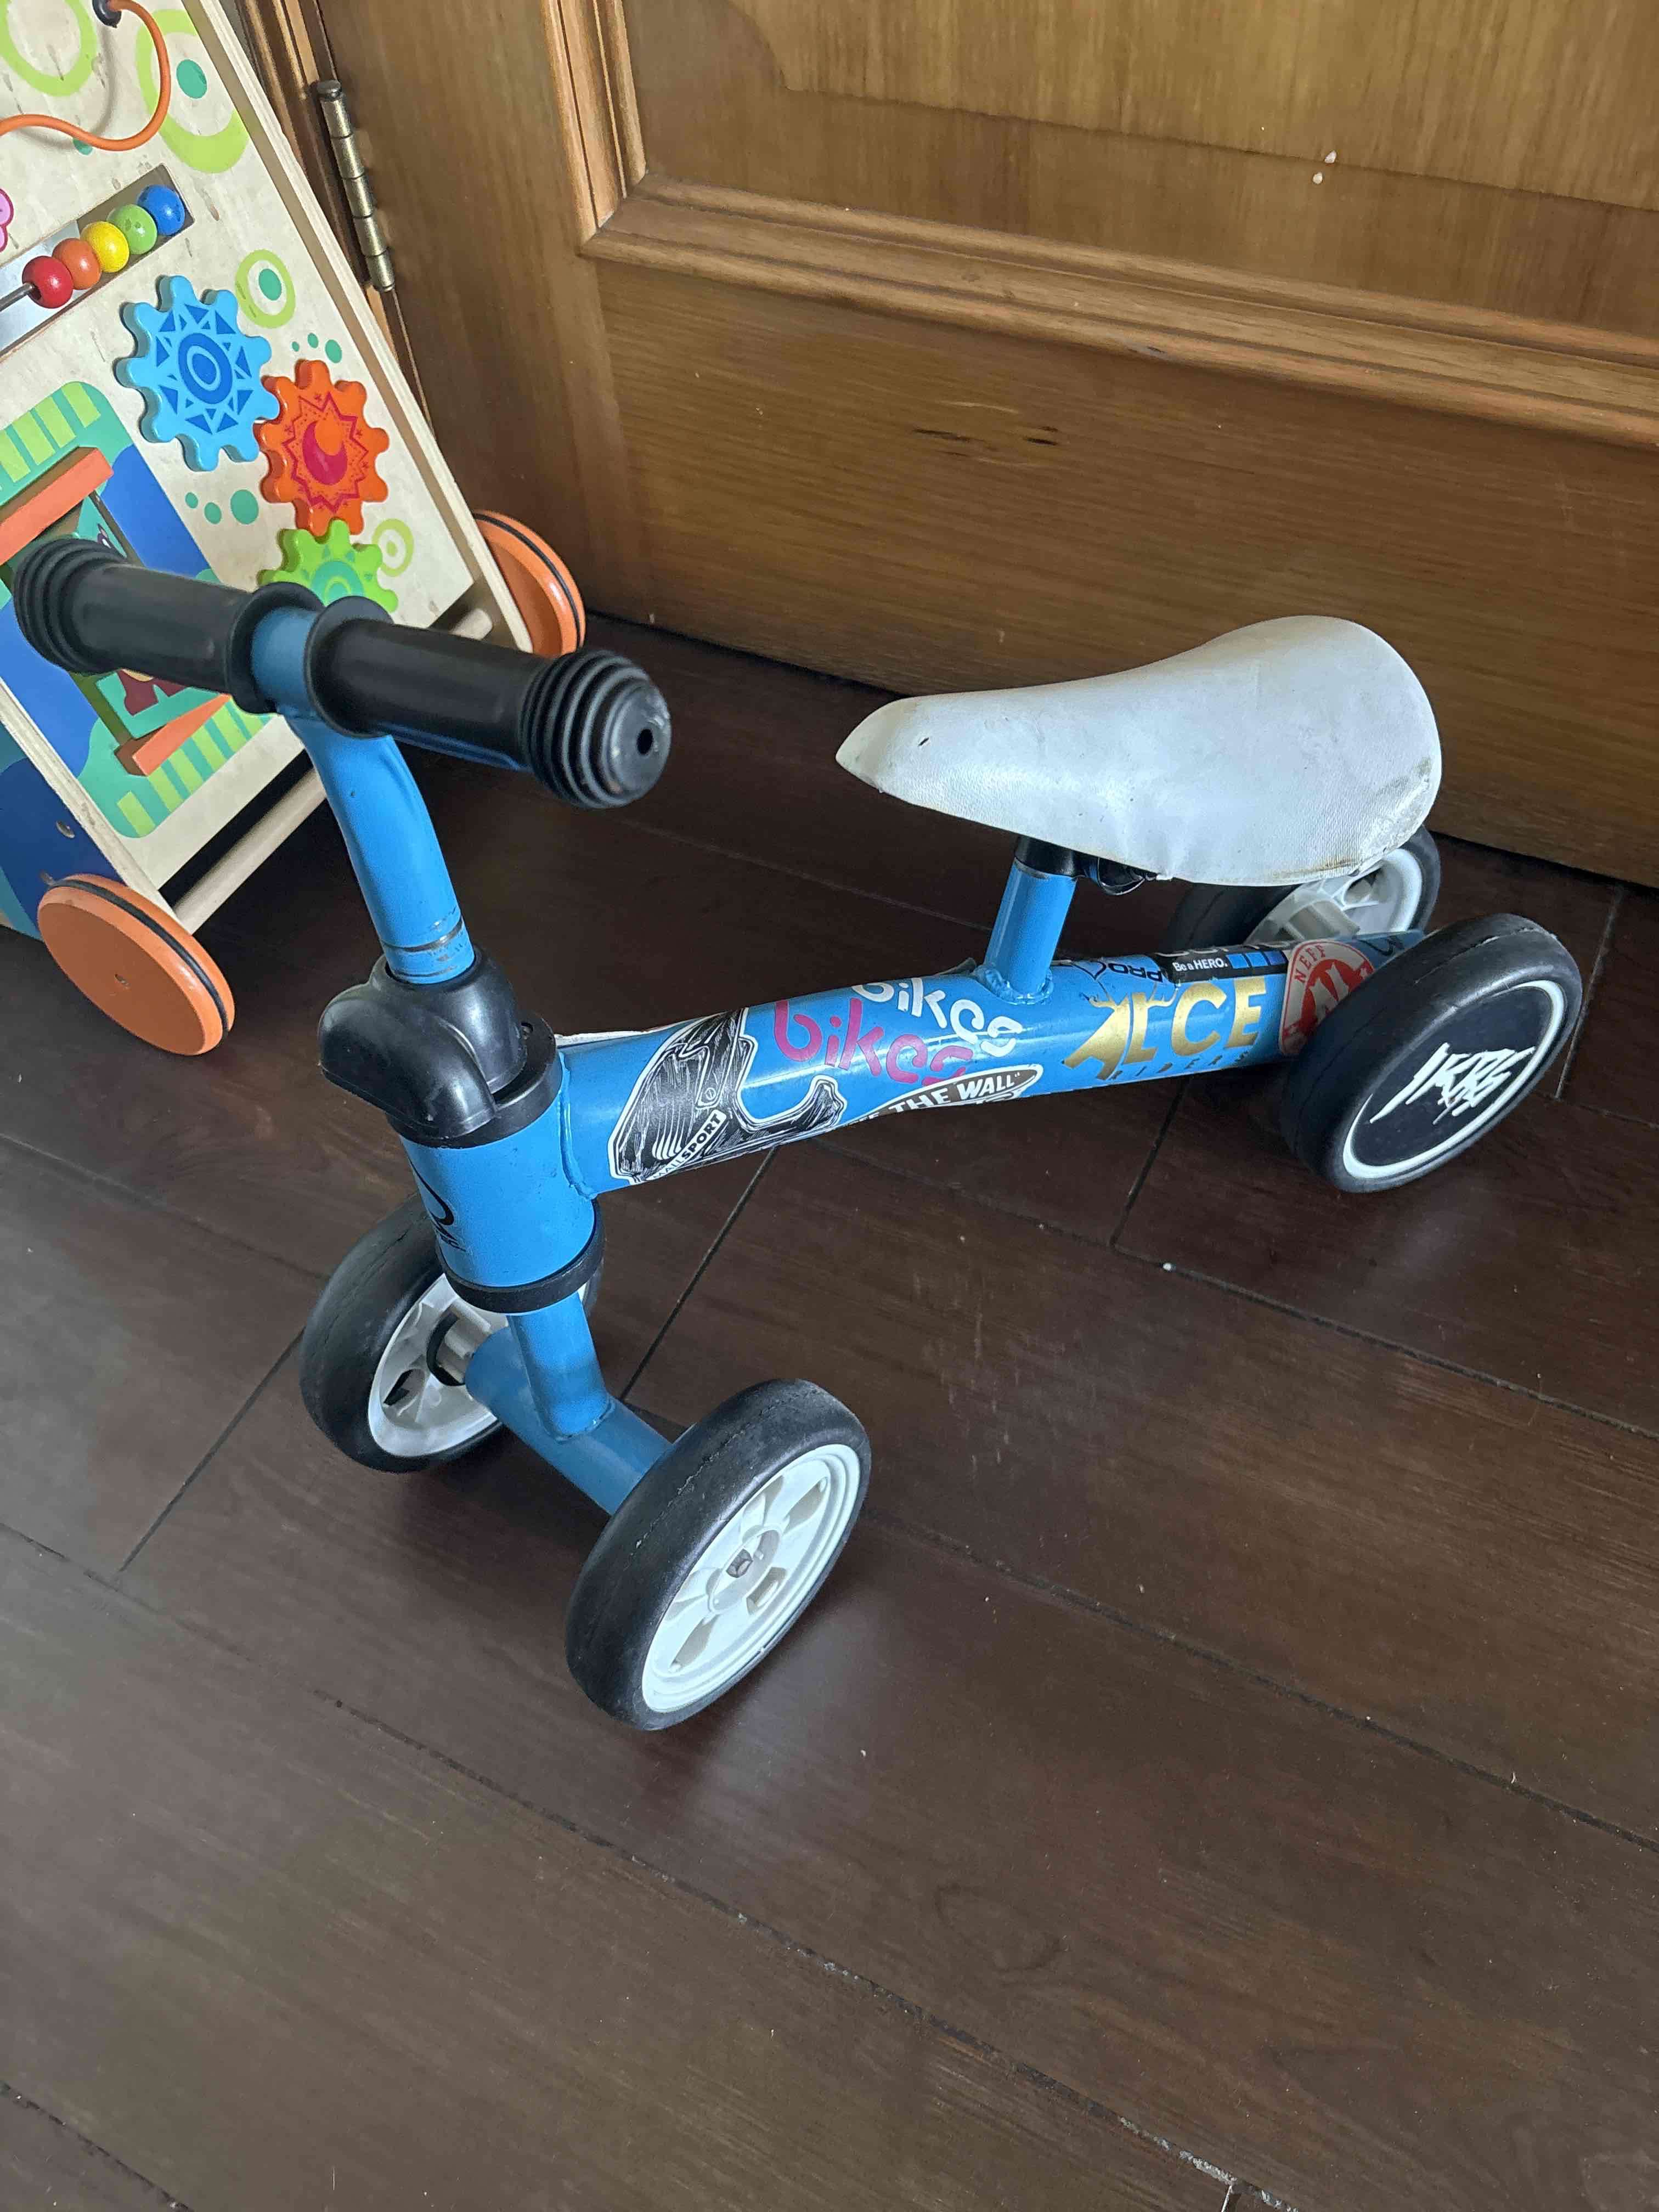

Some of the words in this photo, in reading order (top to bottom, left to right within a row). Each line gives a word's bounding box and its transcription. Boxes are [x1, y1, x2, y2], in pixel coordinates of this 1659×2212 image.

[1193, 958, 1228, 970] HERO.
[774, 998, 974, 1086] bikes
[888, 1088, 951, 1113] THE
